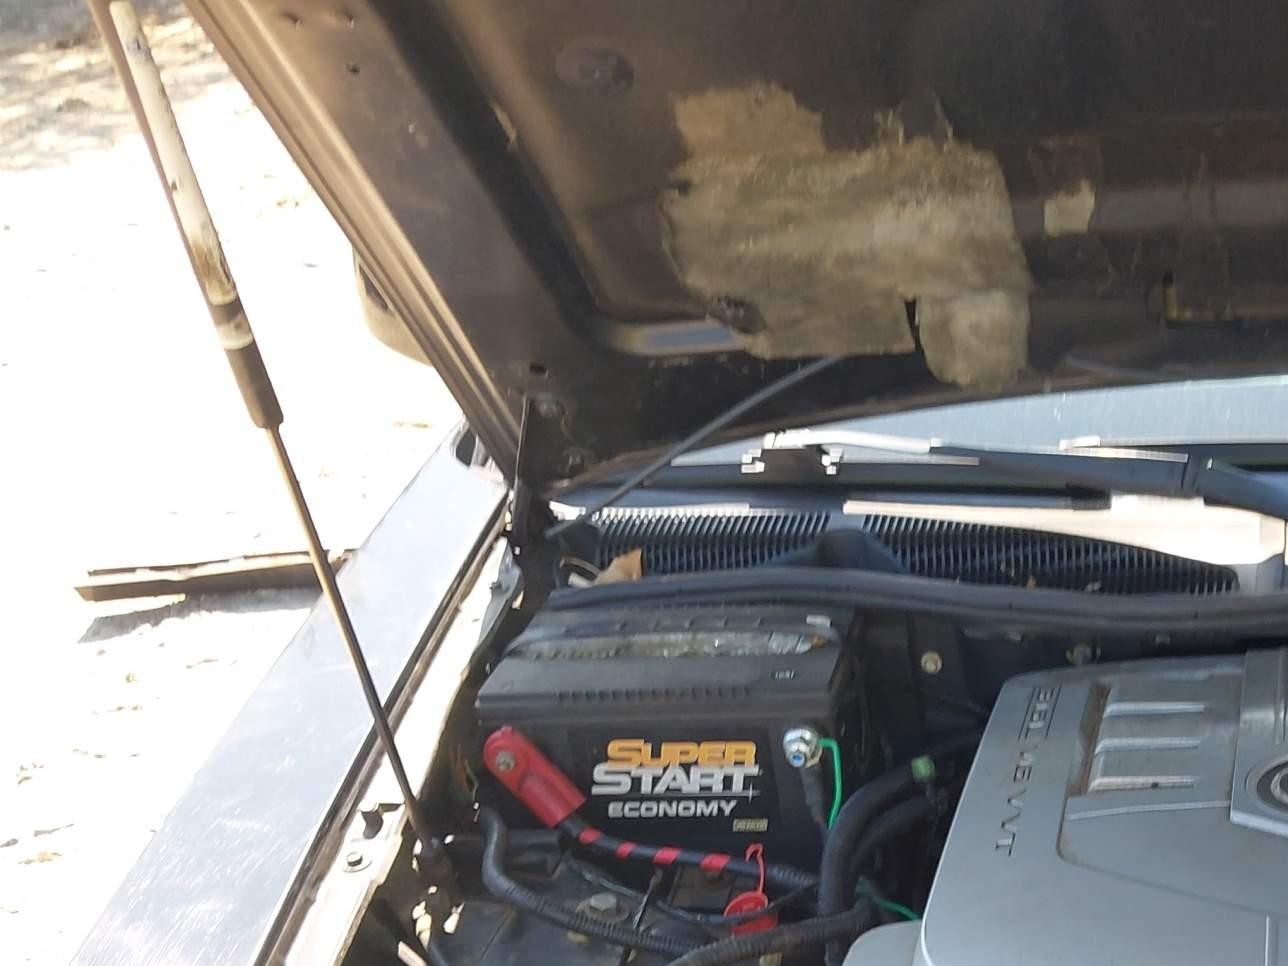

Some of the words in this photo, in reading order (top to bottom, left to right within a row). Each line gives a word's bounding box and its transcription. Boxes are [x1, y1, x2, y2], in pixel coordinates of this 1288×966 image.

[607, 739, 757, 768] SUPER
[591, 763, 760, 796] START
[608, 799, 738, 818] ECONOMY
